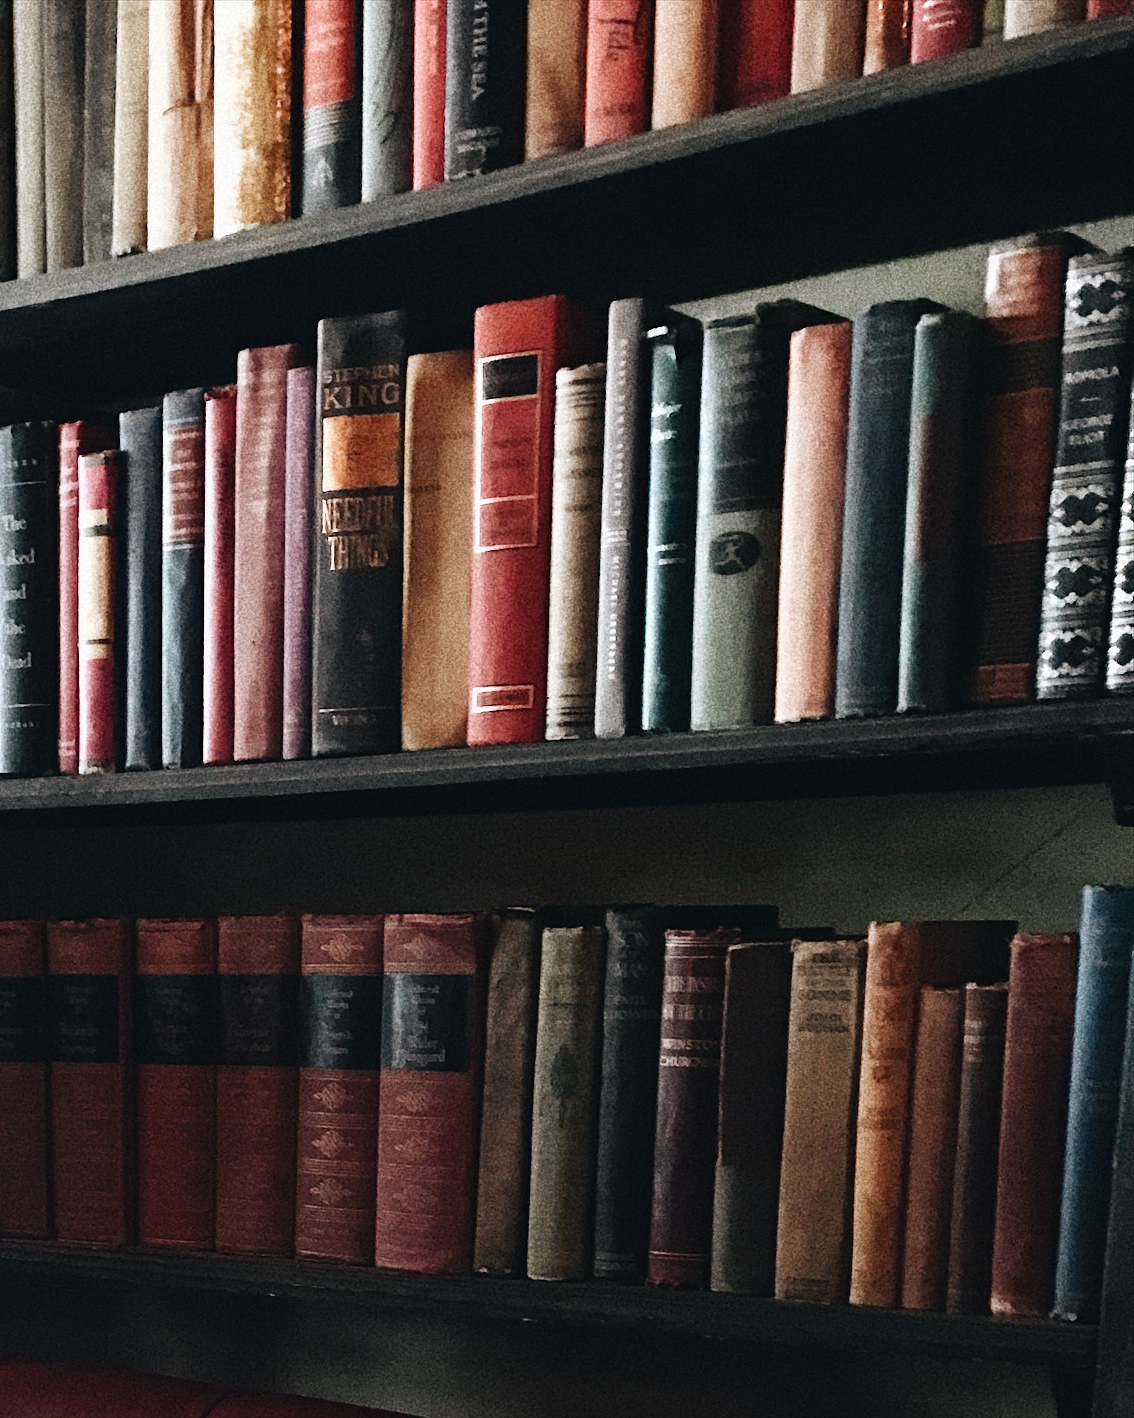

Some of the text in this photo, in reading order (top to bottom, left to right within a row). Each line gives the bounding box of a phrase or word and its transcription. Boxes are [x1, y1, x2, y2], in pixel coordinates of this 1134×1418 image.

[471, 12, 489, 101] THE SEA
[322, 364, 400, 384] STEPHEN
[323, 382, 400, 410] KING
[1, 514, 27, 531] The
